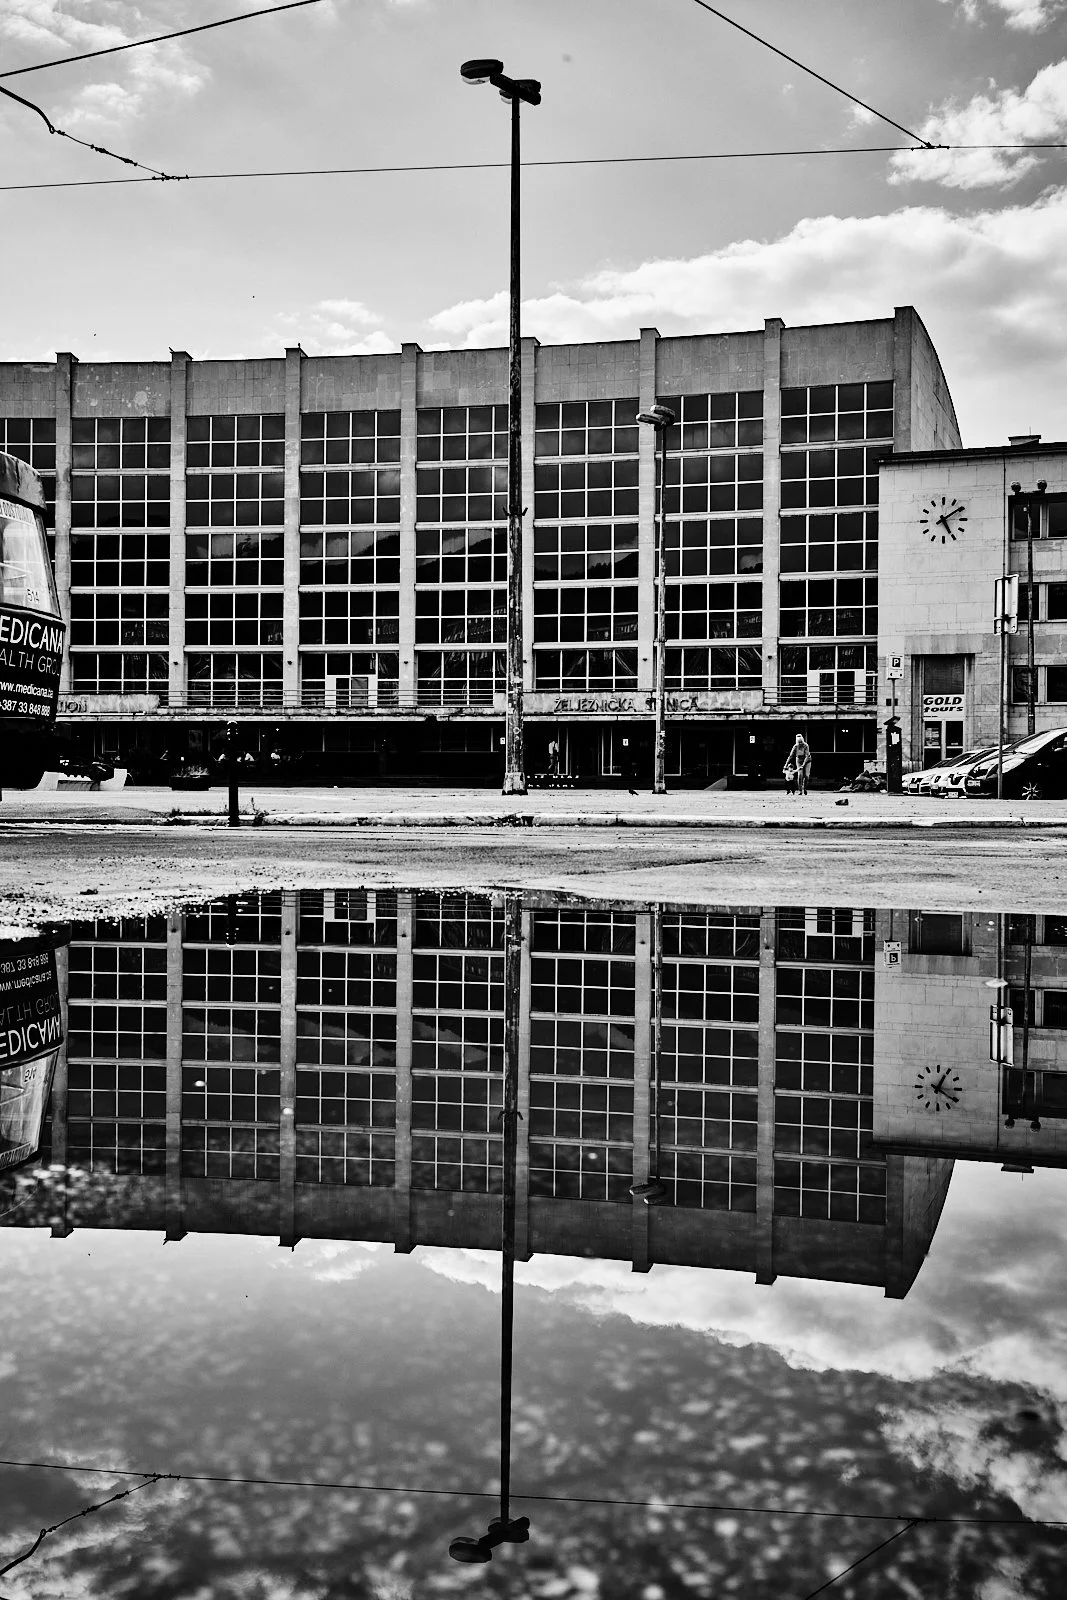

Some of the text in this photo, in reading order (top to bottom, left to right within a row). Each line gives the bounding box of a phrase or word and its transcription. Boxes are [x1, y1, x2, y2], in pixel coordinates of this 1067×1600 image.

[26, 589, 40, 604] 514
[18, 702, 28, 713] 33
[645, 697, 699, 712] STNICA
[923, 697, 962, 705] GOLD
